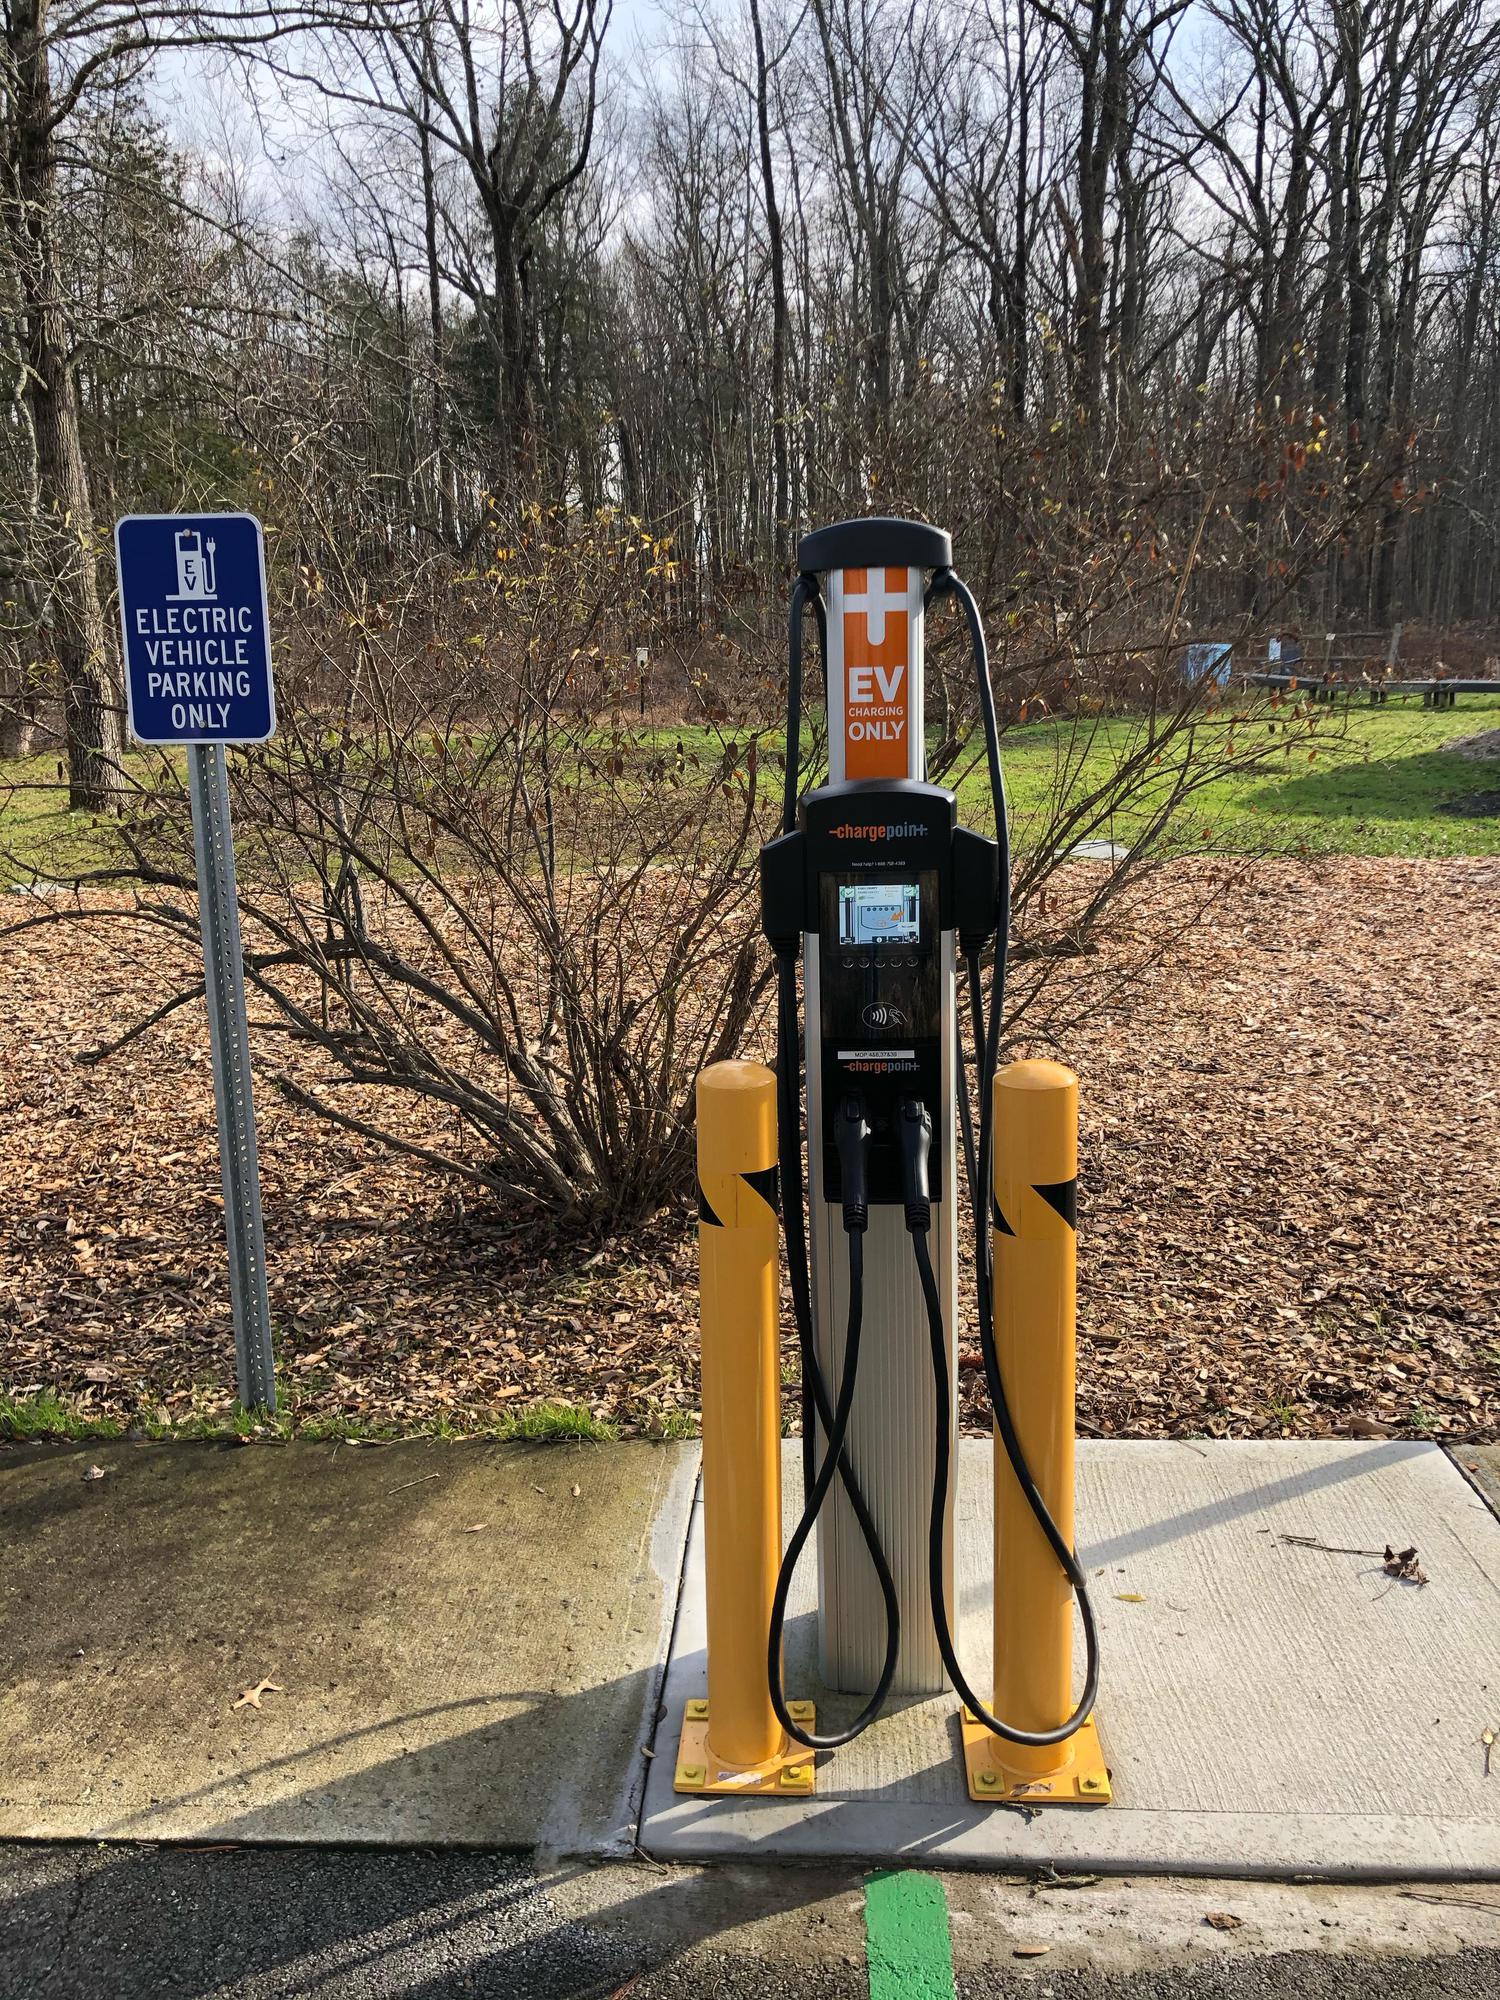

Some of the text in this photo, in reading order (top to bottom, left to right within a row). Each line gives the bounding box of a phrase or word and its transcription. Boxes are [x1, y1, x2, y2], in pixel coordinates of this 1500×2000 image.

[136, 607, 253, 634] ELECTRIC
[145, 639, 249, 666] VEHICLE
[148, 671, 251, 698] PARKING
[848, 665, 905, 703] EV
[171, 703, 231, 729] ONLY
[848, 706, 904, 717] CHARGING
[848, 720, 905, 741] ONLY
